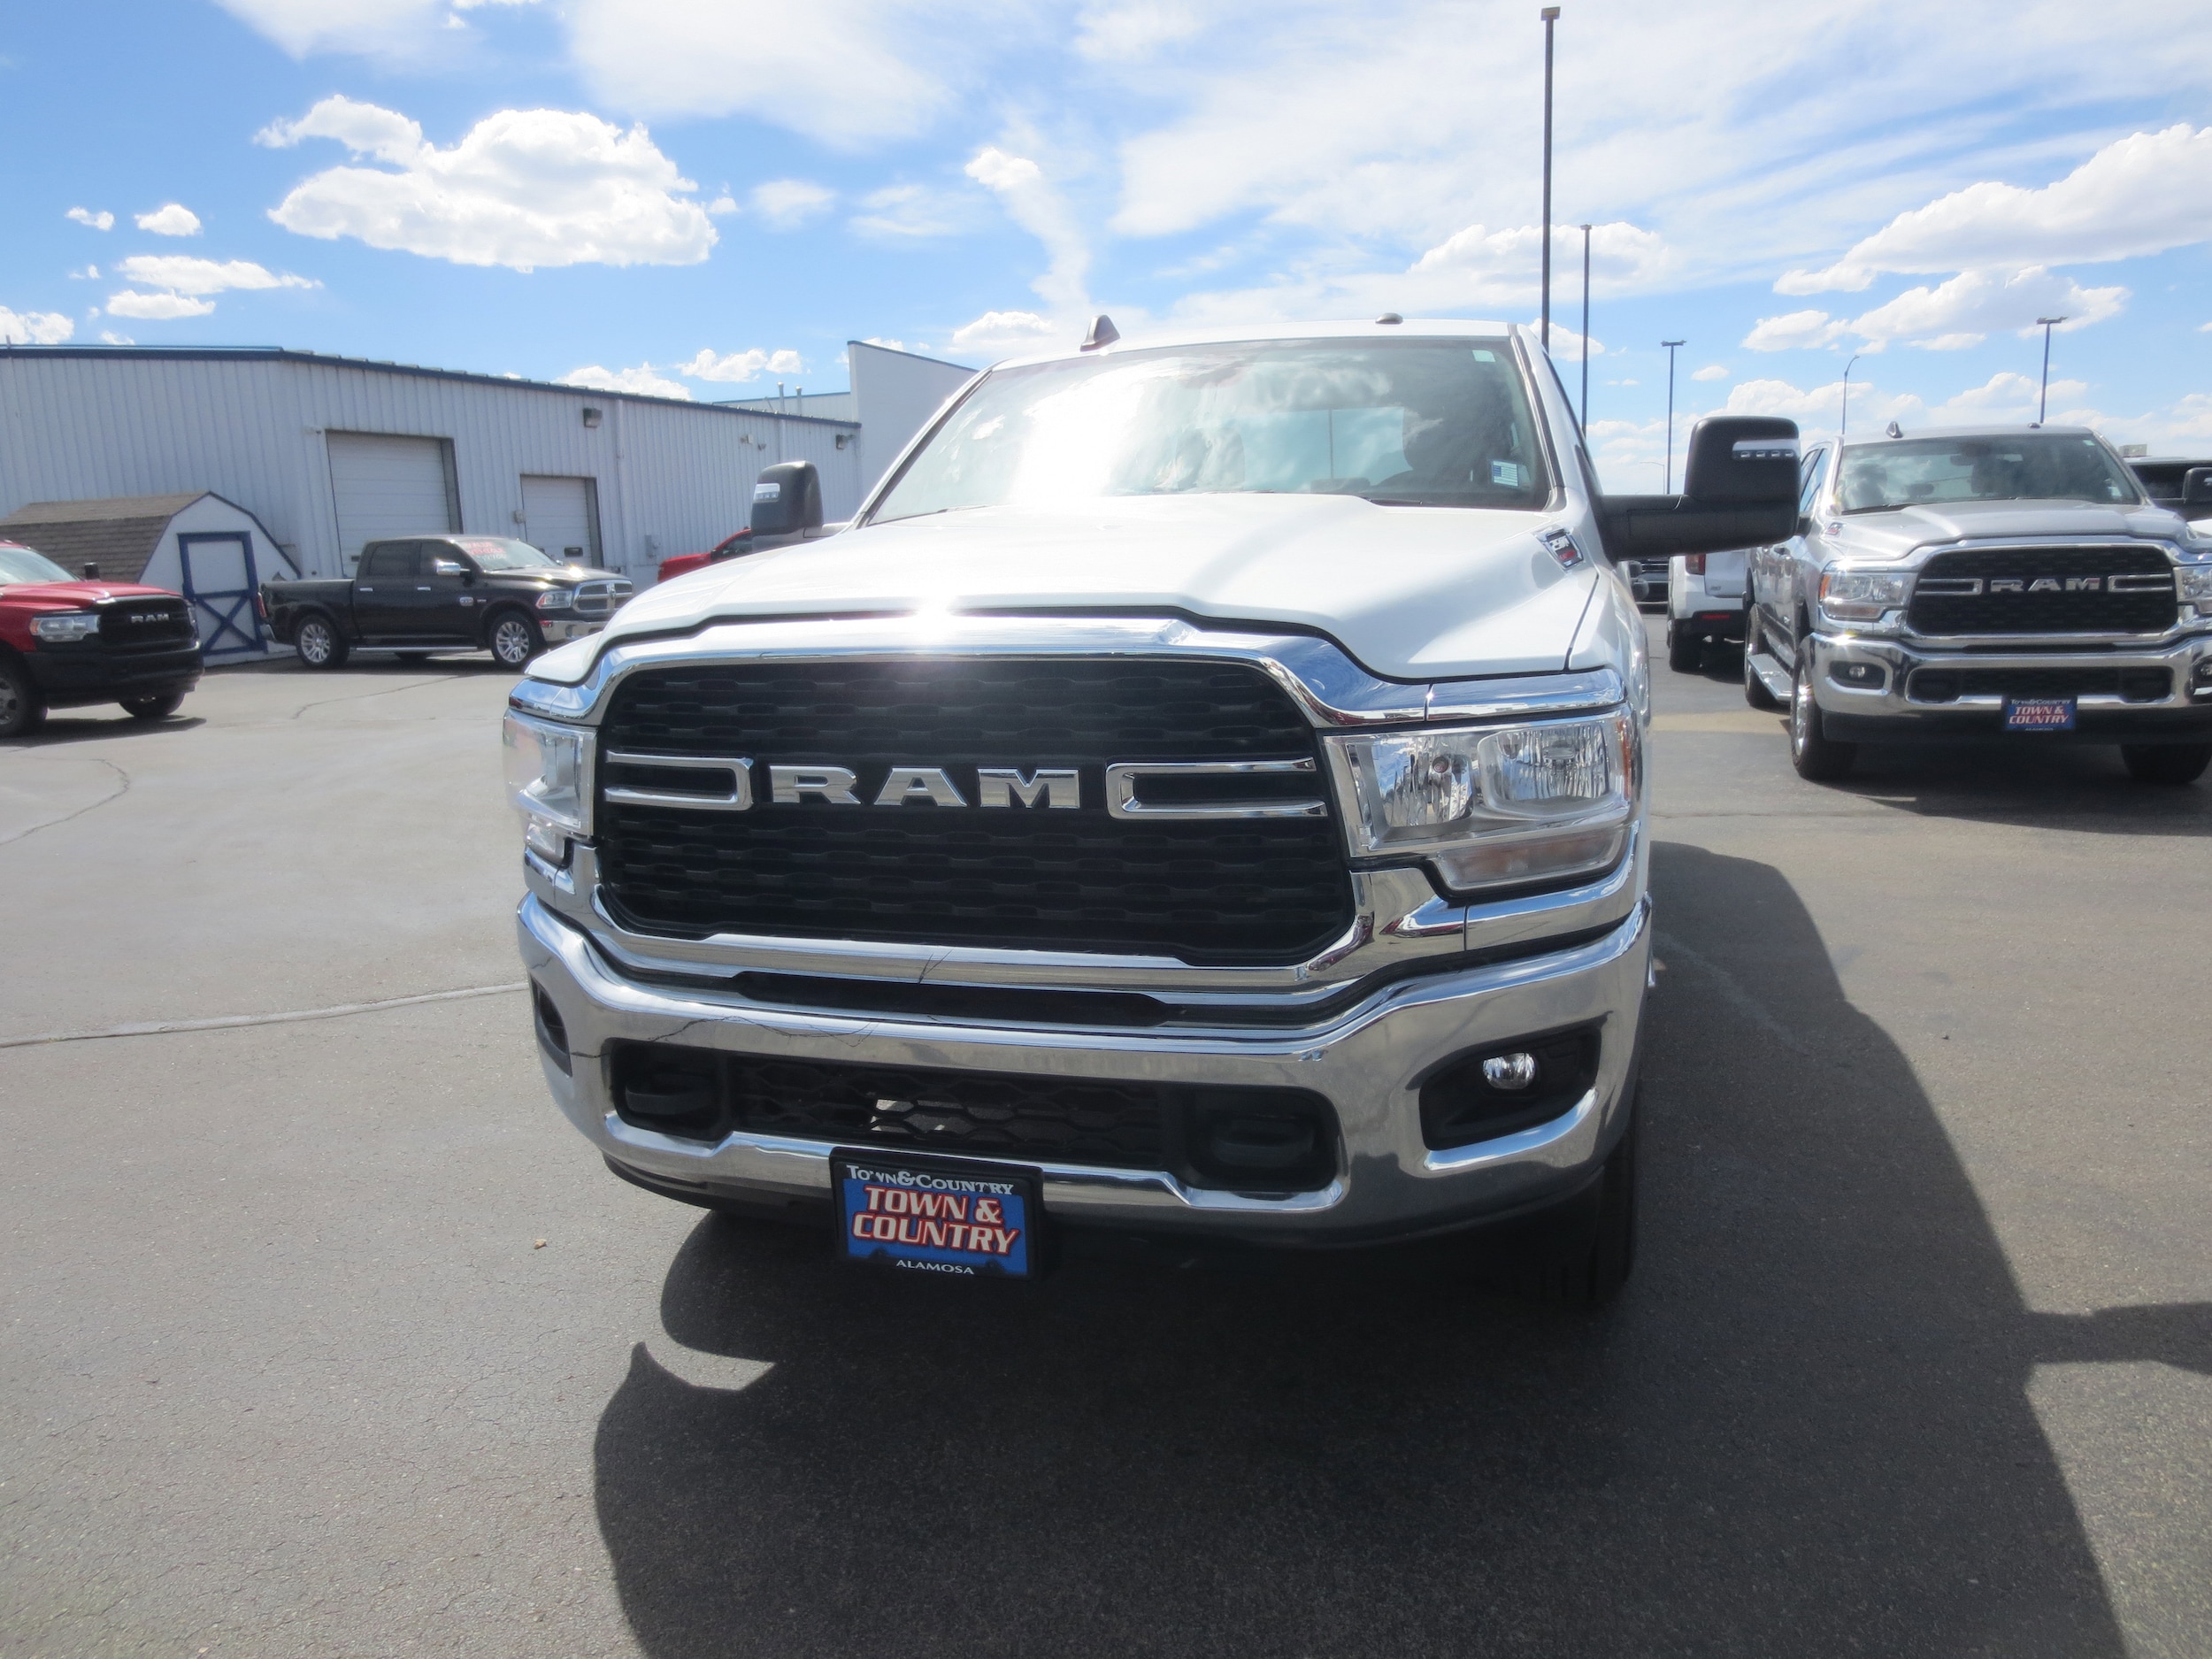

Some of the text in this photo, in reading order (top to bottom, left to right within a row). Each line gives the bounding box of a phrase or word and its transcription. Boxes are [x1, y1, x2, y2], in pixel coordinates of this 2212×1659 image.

[1991, 578, 2101, 592] RAM
[131, 613, 170, 623] RAM
[2015, 705, 2053, 715] TOWN
[2008, 714, 2070, 725] COUNTRY
[769, 764, 1080, 809] RAM
[864, 1186, 1003, 1225] TOWN &
[852, 1212, 1019, 1256] COUNTRY
[896, 1259, 974, 1275] ALAMOSA
